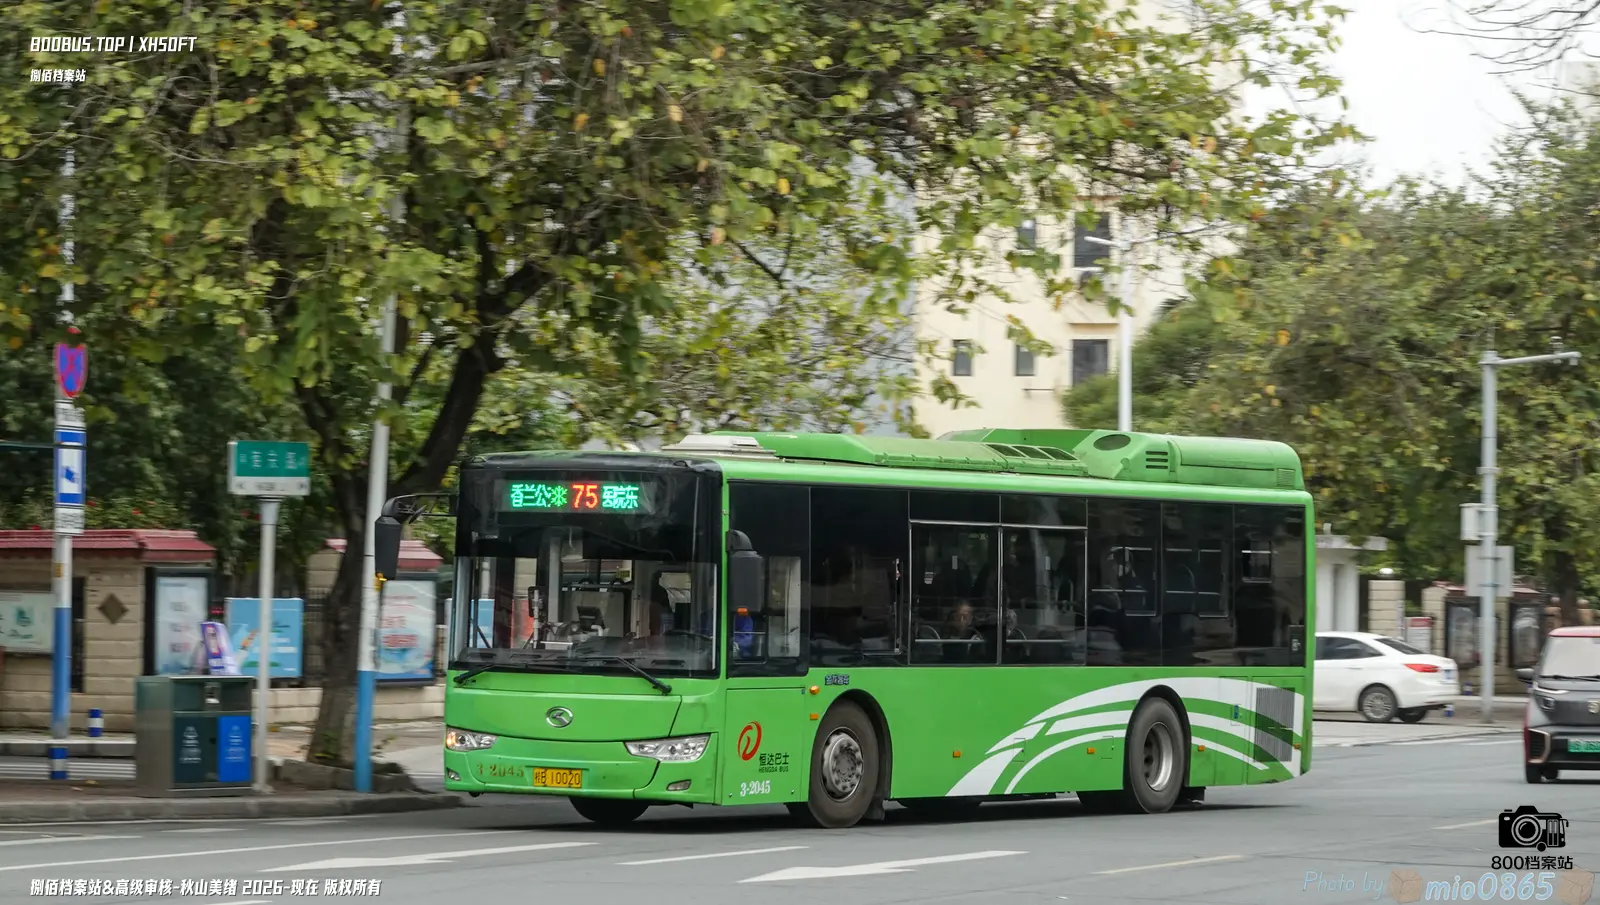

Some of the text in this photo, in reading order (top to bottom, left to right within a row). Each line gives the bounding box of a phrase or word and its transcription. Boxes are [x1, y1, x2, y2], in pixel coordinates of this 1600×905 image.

[572, 484, 598, 508] 75
[602, 485, 639, 509] 医院东
[759, 752, 790, 766] 恒达巴士
[740, 780, 771, 797] 3-2045
